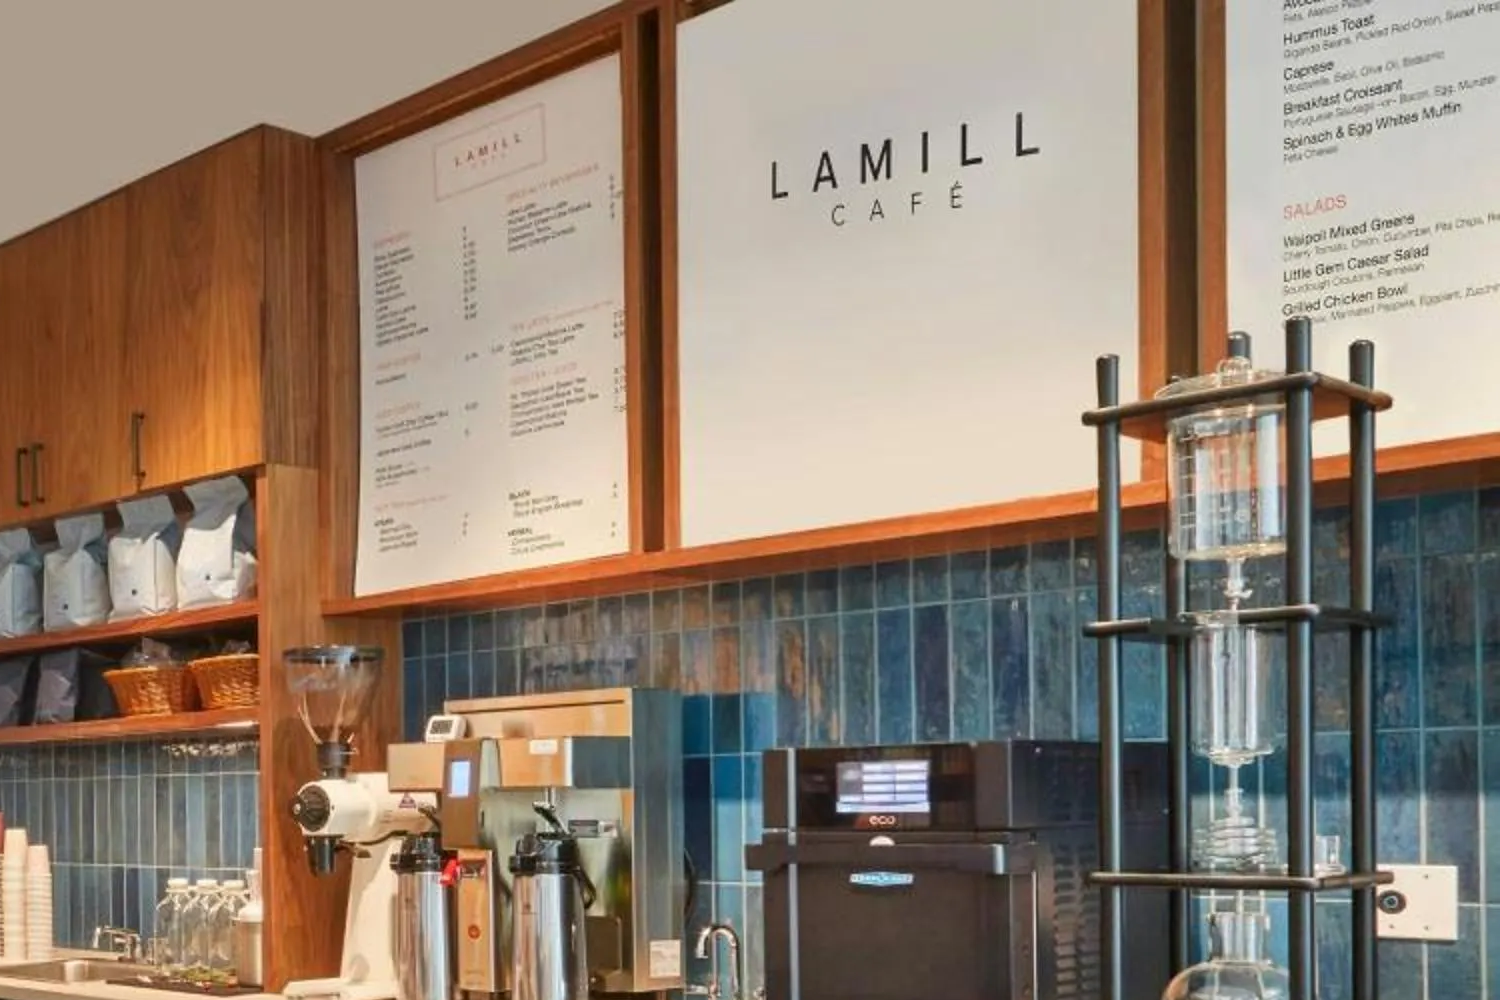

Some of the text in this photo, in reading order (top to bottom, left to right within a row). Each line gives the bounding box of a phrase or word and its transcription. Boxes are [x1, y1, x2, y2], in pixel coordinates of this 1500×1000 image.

[1283, 14, 1374, 45] Hummus Toast
[1283, 60, 1335, 80] Caprese
[1283, 79, 1403, 116] Breakfast Croissant
[1283, 101, 1462, 151] Spinach & Egg Whites Muffin
[454, 132, 522, 168] LAMILL
[770, 111, 1040, 201] LAMILL
[830, 180, 965, 228] CAFÉ
[1283, 193, 1347, 220] SALADS
[1329, 221, 1367, 239] Mixed
[1370, 213, 1415, 231] Greens
[1283, 243, 1430, 283] Little Gem Caesar Salad
[1282, 283, 1409, 317] Grilled Chicken Bowl
